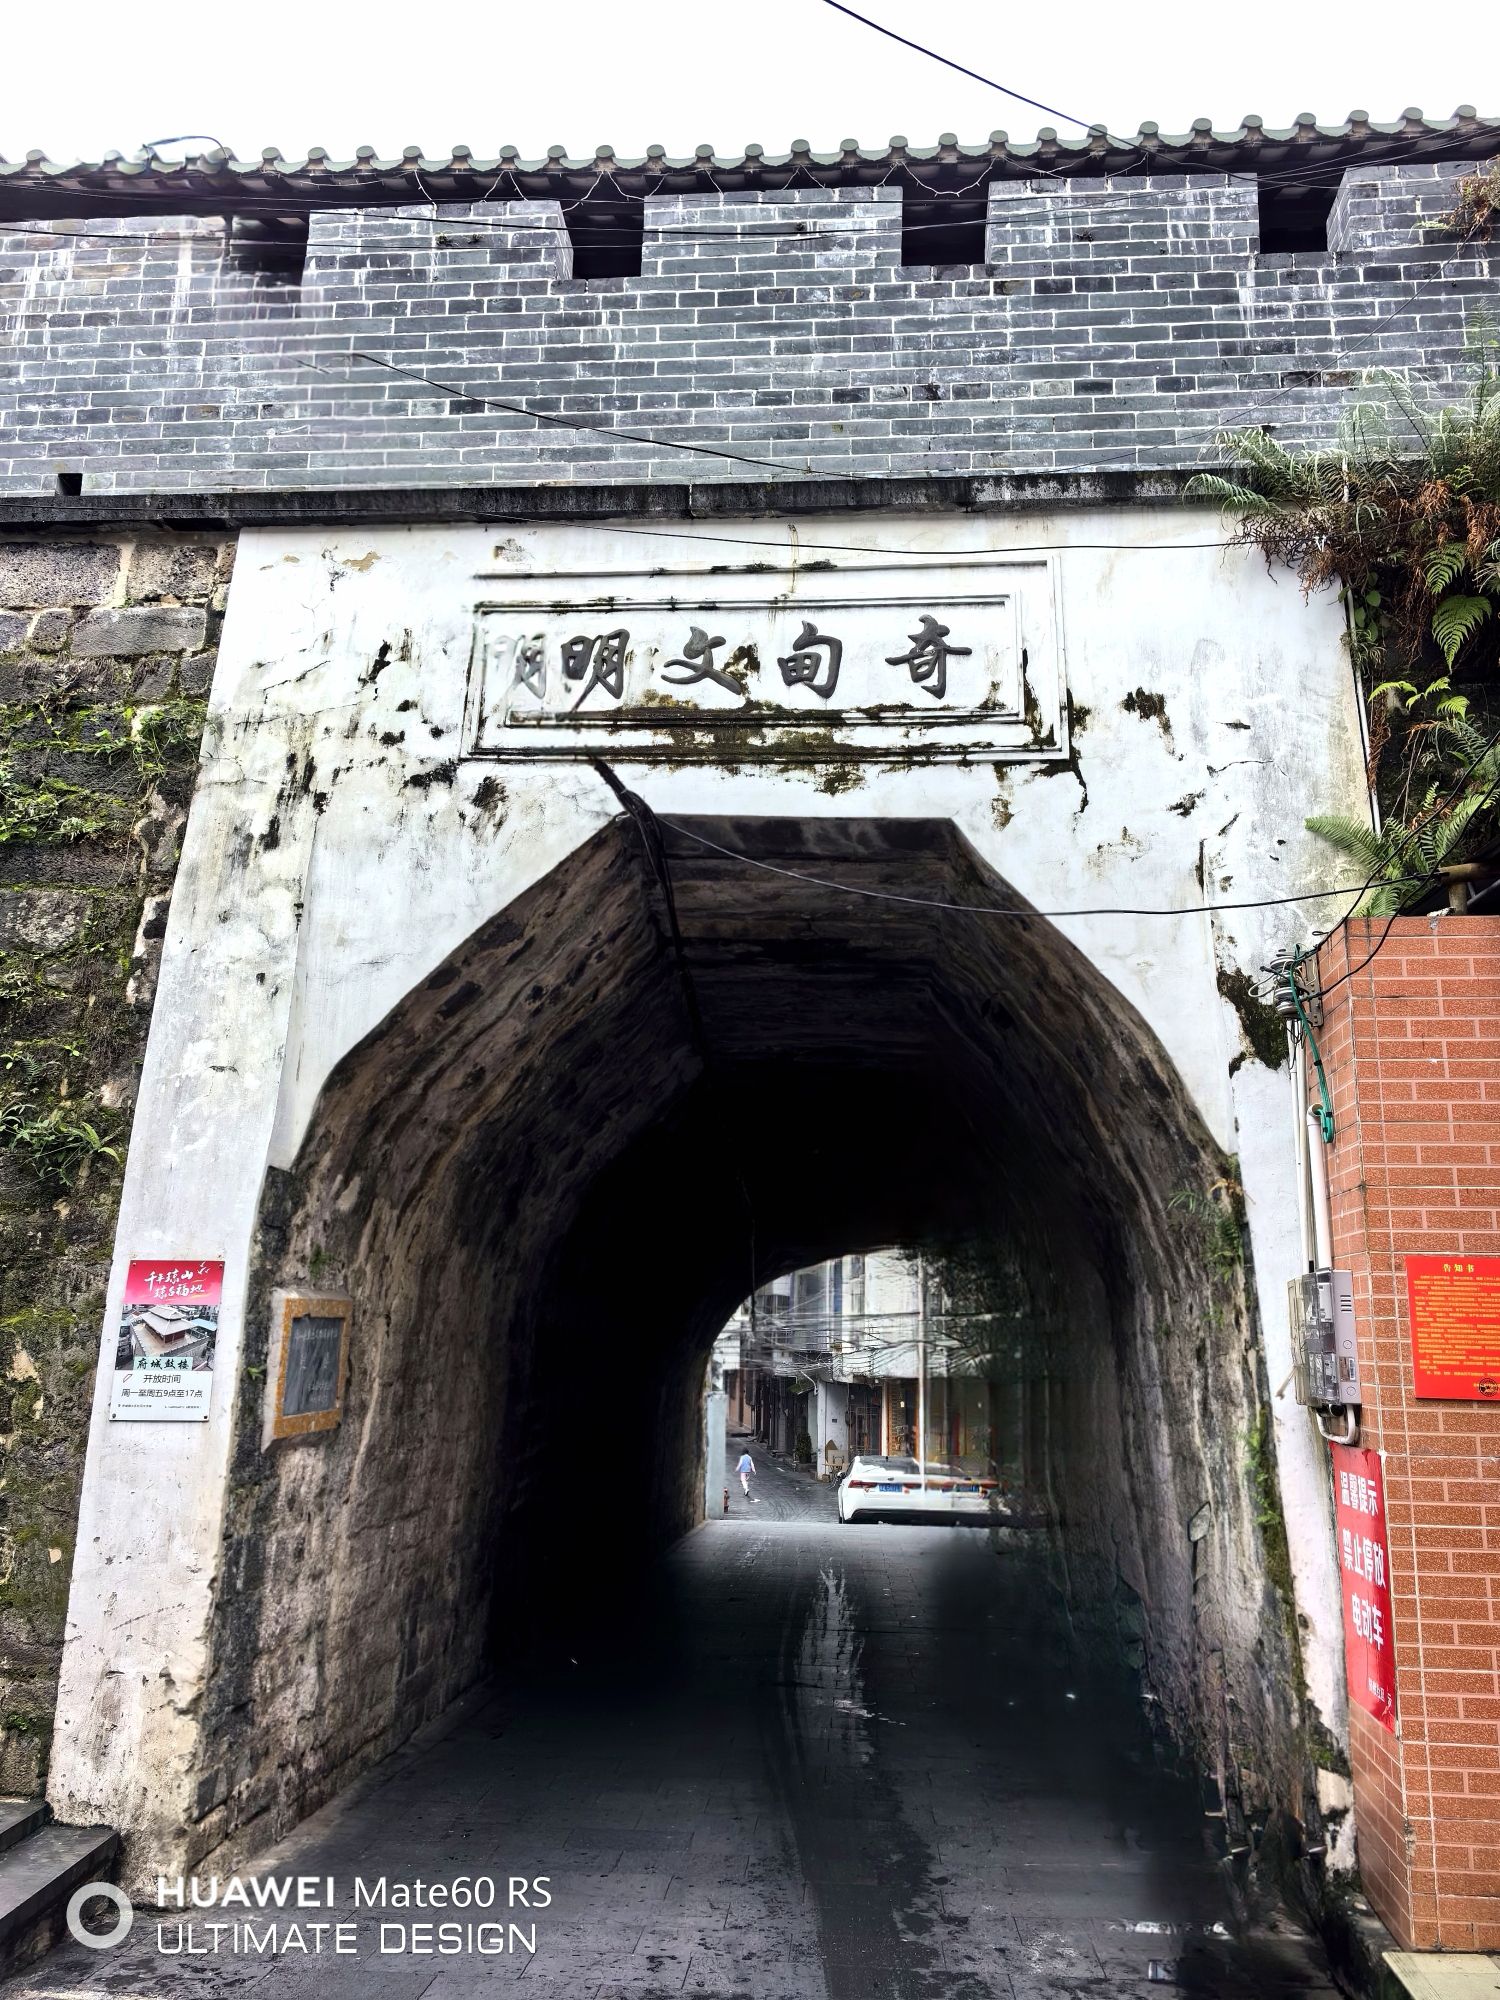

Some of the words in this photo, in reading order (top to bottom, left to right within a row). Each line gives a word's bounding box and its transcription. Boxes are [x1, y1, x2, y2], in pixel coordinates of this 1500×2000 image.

[121, 1389, 203, 1398] 周一至周五9点至17点
[143, 1374, 181, 1384] 开放时间
[1340, 1471, 1378, 1516] 温馨提示
[1343, 1528, 1386, 1590] 禁止停放
[1352, 1592, 1384, 1652] 电动车
